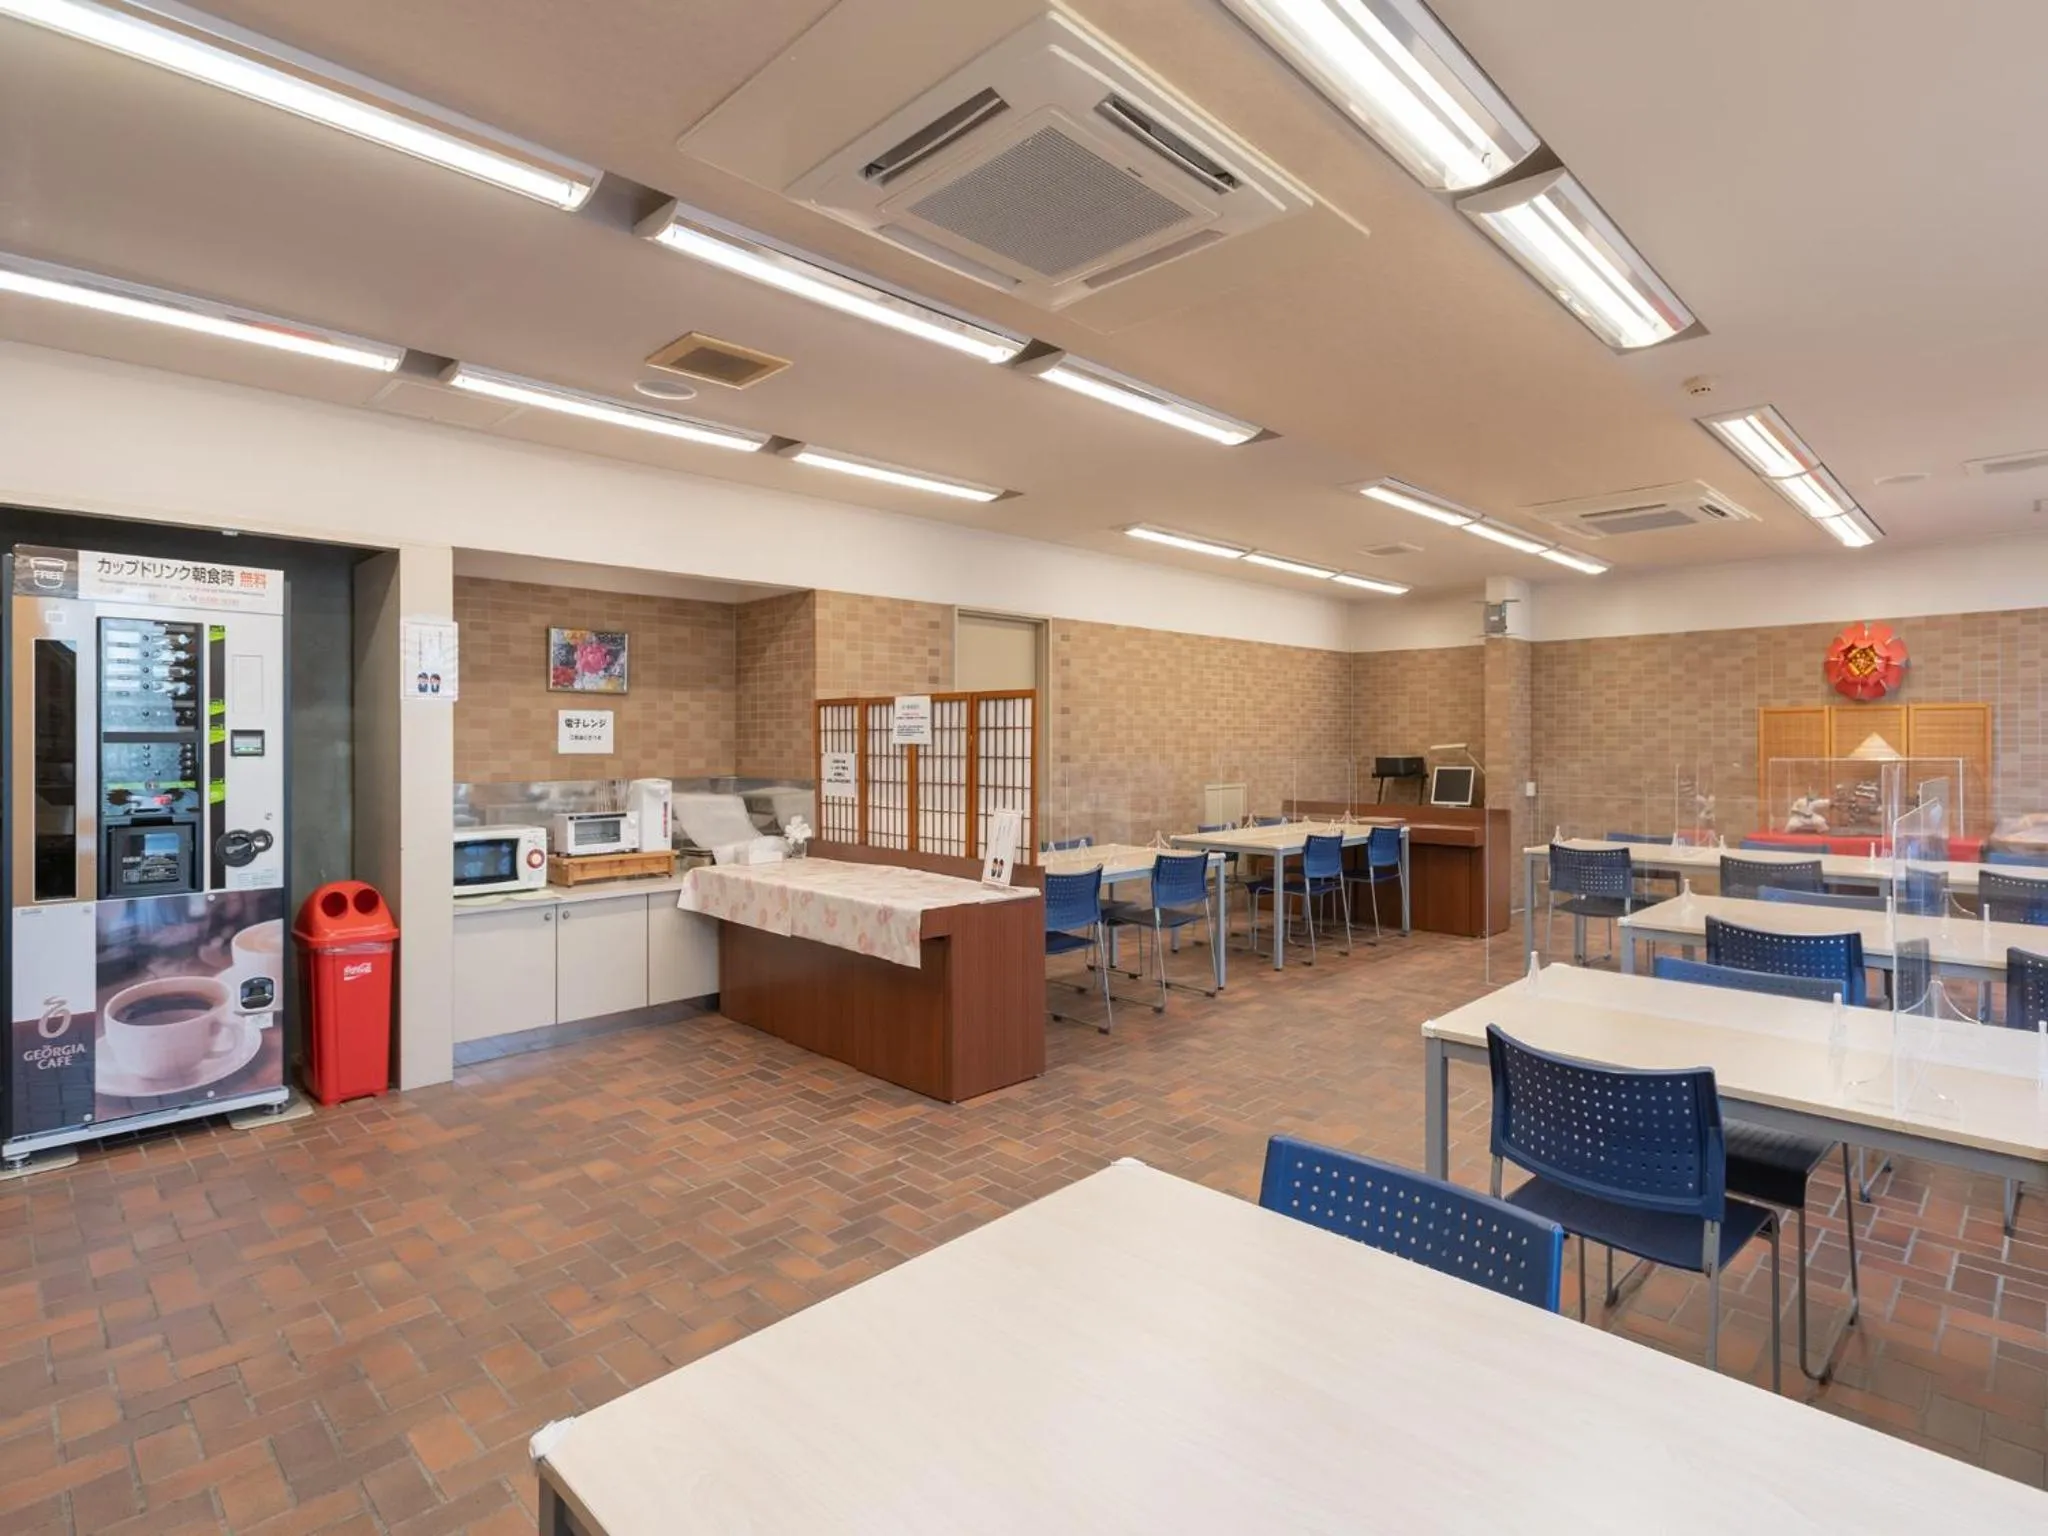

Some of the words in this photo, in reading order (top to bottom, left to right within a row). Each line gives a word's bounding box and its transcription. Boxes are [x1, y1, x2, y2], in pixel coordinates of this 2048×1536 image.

[97, 557, 235, 587] カップドリンク朝食時
[239, 570, 267, 589] 無料
[565, 718, 607, 728] 電子レンジ
[23, 1043, 86, 1061] GEORGIA
[37, 1055, 73, 1070] CAFE
